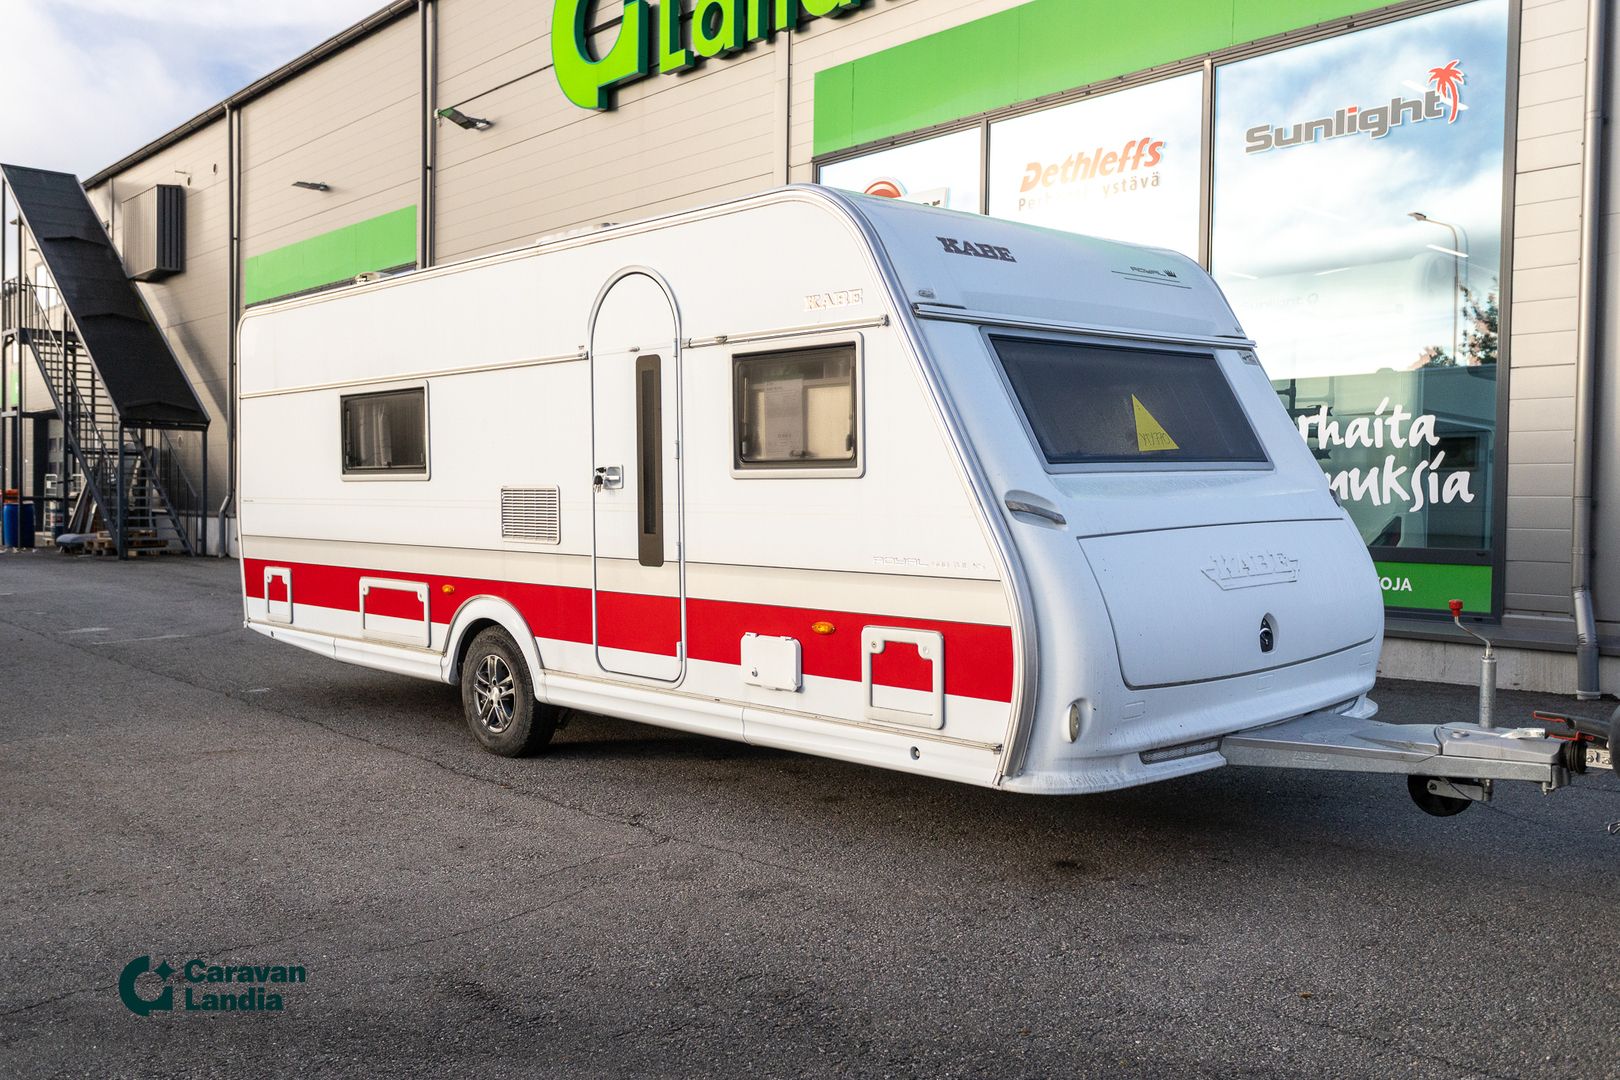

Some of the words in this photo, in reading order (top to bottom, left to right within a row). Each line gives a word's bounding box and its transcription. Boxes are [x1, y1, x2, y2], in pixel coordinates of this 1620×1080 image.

[1245, 90, 1444, 153] Sunlight
[1019, 136, 1164, 193] Dethleffs
[1102, 170, 1161, 199] ystävä
[936, 236, 1017, 263] KABE
[804, 287, 863, 311] KABE
[1297, 397, 1441, 450] rhaita
[1377, 576, 1413, 592] OJA
